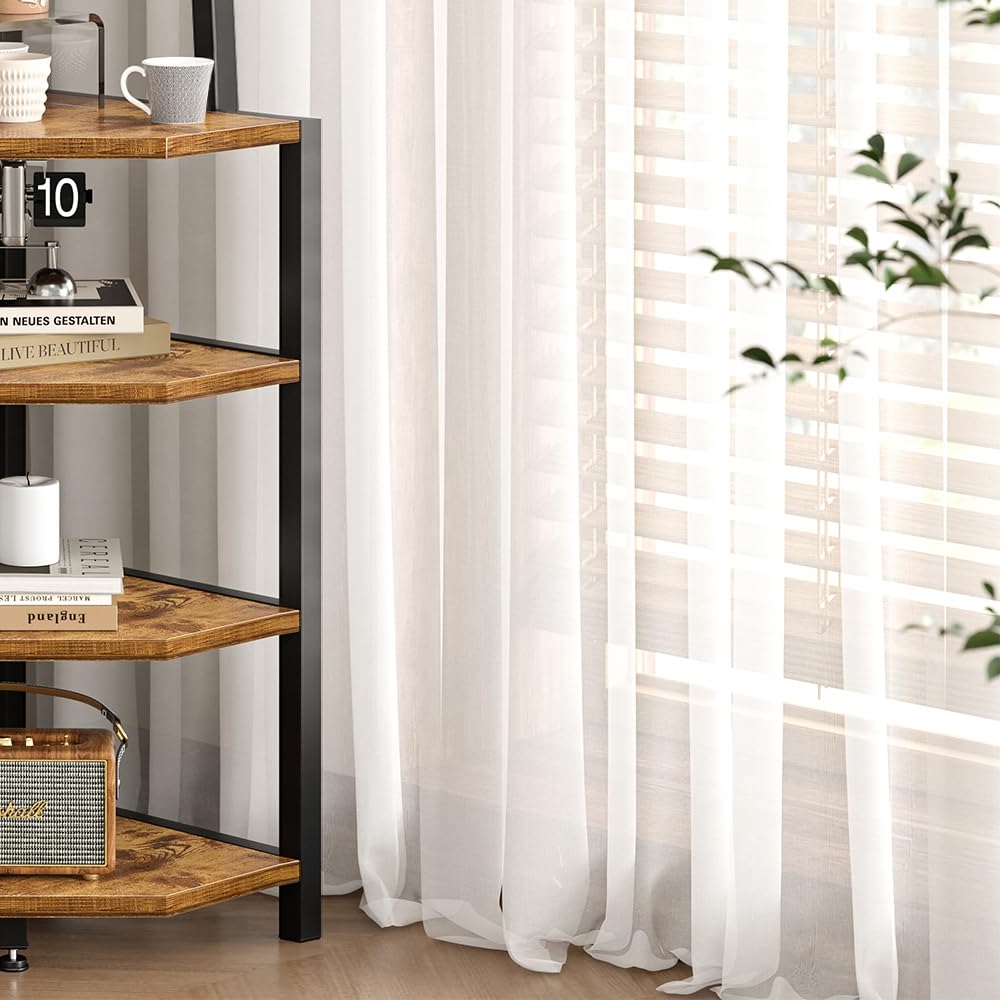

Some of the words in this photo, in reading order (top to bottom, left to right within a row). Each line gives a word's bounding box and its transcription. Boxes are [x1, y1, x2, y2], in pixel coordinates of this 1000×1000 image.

[37, 177, 79, 218] 10
[12, 316, 50, 326] NEUES
[53, 316, 116, 326] GESTALTEN
[1, 345, 35, 361] LIVE
[38, 338, 121, 358] BEAUTIFUL
[27, 610, 86, 624] England
